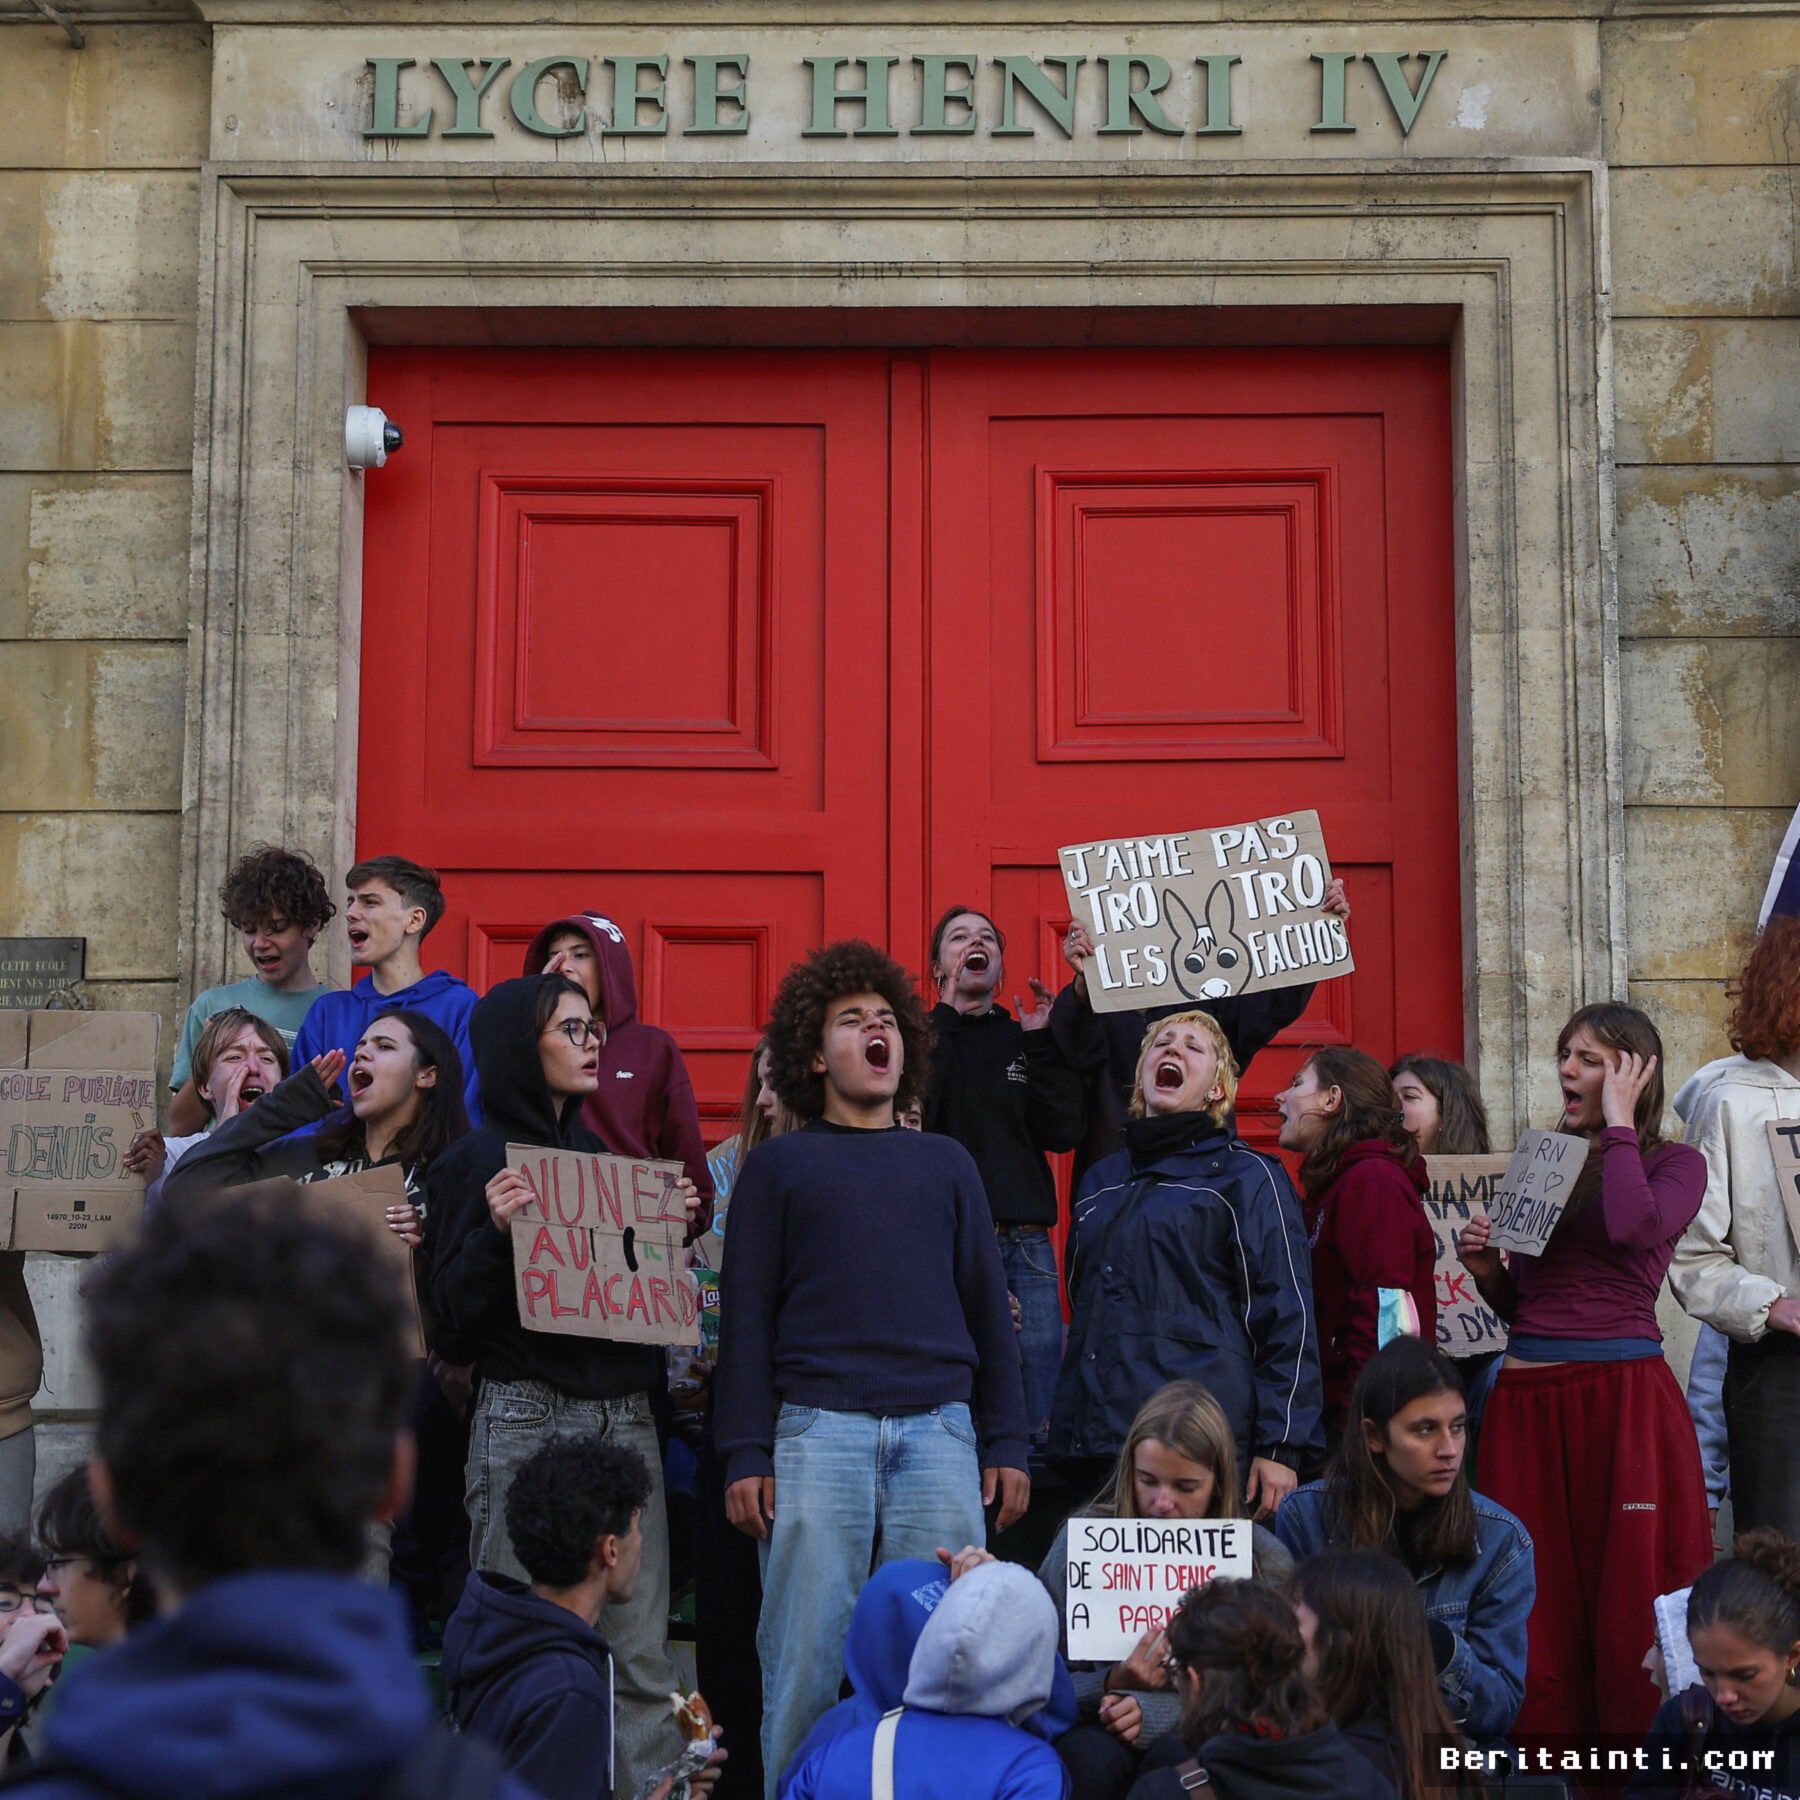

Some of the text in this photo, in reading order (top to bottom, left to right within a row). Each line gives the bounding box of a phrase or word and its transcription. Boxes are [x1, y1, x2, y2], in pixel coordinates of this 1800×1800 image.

[363, 49, 1449, 140] LYCEE HENRI IV
[1210, 818, 1299, 869] PAS
[1081, 853, 1326, 936] TRO TRO
[1094, 918, 1349, 990] LES FACHOS
[1517, 1165, 1536, 1185] de
[1534, 1137, 1568, 1163] RN
[520, 1156, 689, 1230] NUNEZ
[529, 1226, 590, 1271] AU
[521, 1266, 698, 1327] PLACARD
[1068, 1561, 1092, 1590] DE
[1102, 1563, 1159, 1592] SAINT
[1071, 1602, 1091, 1631] A
